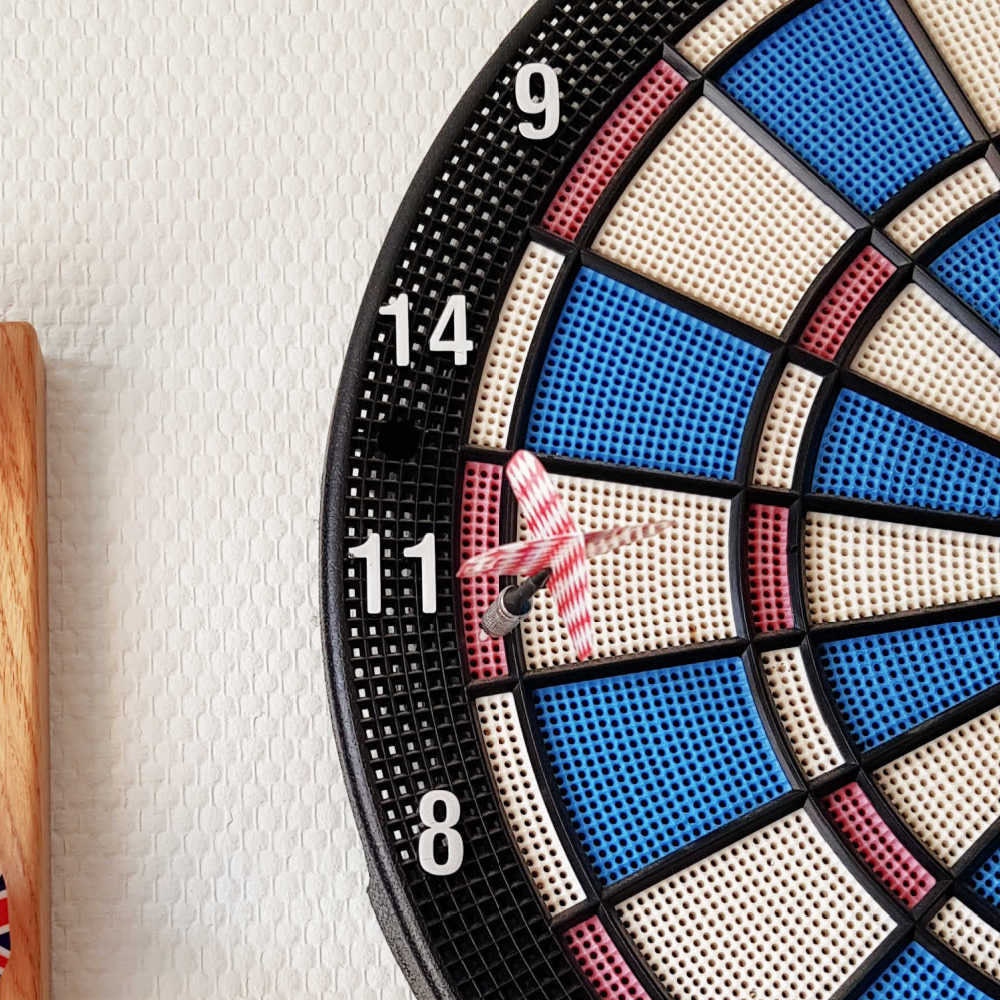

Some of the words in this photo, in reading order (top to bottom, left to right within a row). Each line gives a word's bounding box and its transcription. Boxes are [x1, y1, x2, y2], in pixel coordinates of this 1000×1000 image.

[514, 62, 561, 140] 9
[379, 293, 474, 366] 14
[348, 533, 437, 614] 11
[418, 789, 464, 876] 8
